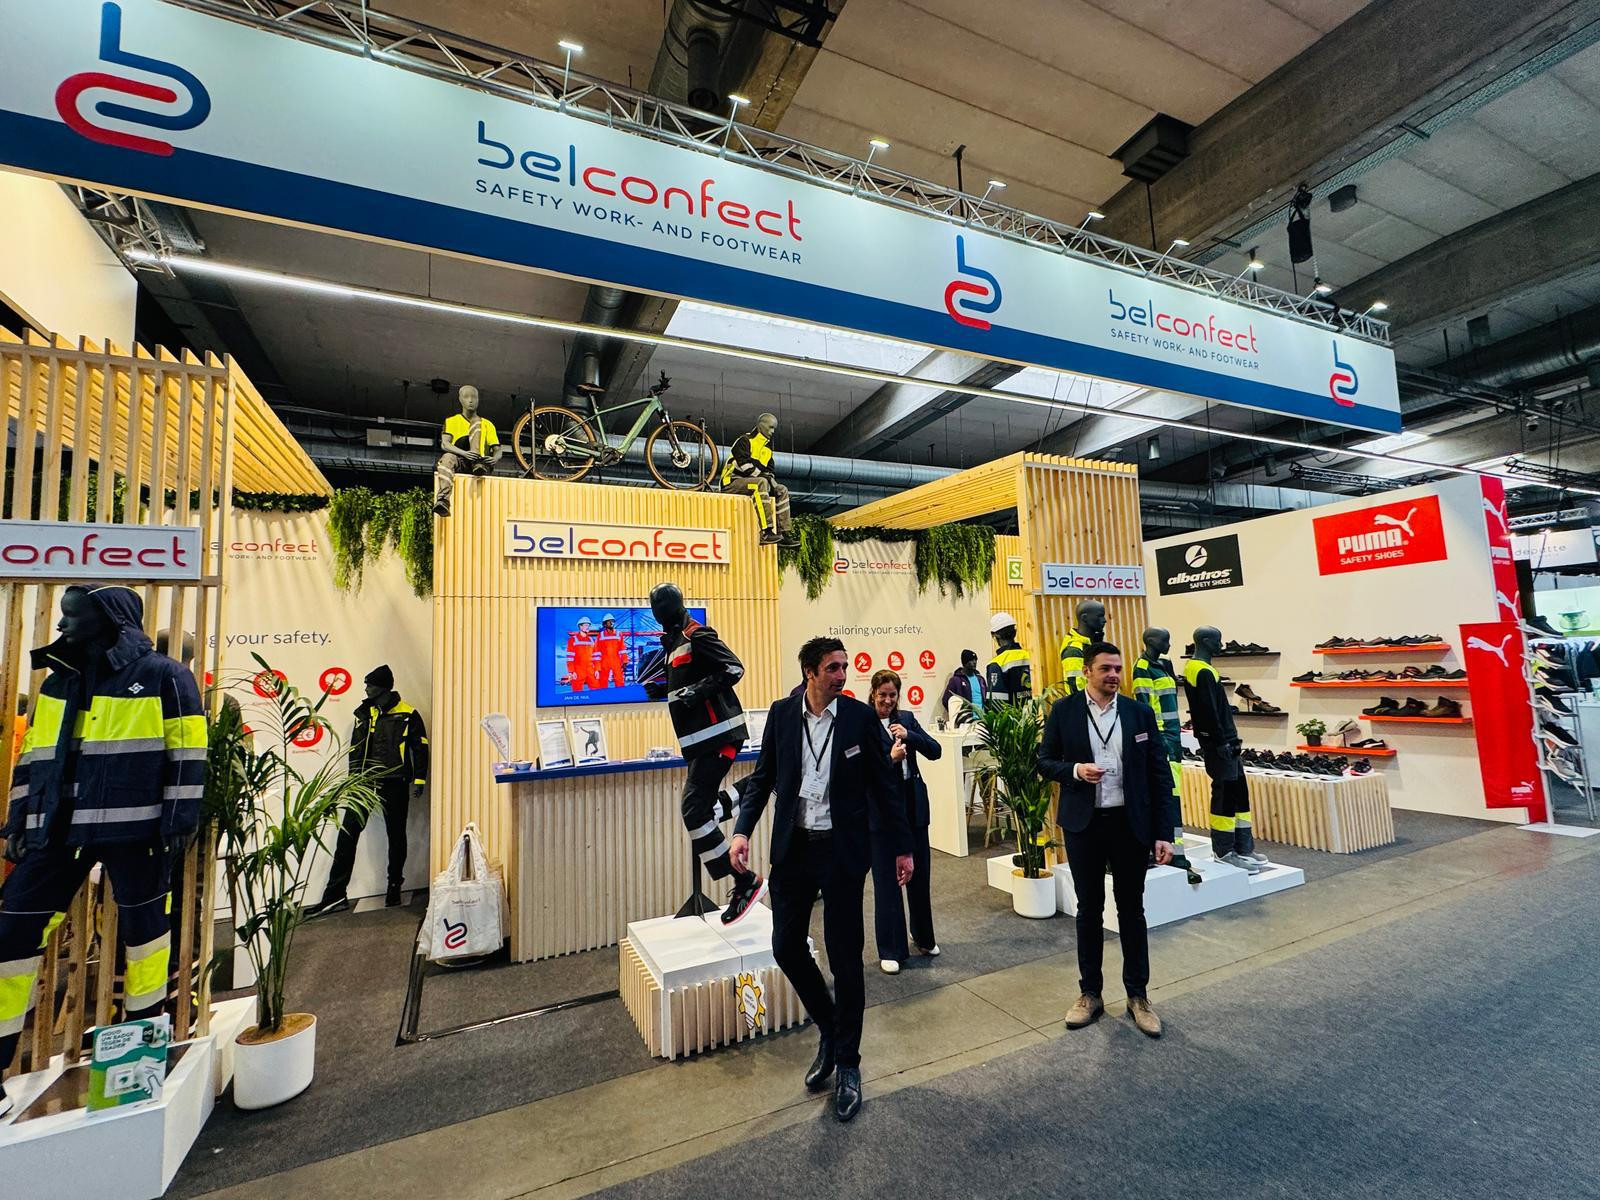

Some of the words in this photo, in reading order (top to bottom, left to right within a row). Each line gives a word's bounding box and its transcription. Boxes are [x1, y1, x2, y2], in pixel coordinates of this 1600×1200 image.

[477, 120, 803, 242] belconfect
[476, 179, 563, 210] SAFETY
[573, 200, 644, 227] WORK-
[652, 220, 693, 240] AND
[701, 231, 802, 265] FOOTWEAR
[1109, 288, 1259, 354] belconfect
[1111, 328, 1150, 345] SAFETY
[1153, 338, 1185, 353] WORK-
[1188, 346, 1208, 359] AND
[1211, 351, 1260, 370] FOOTWEAR
[2, 534, 187, 567] onfect
[513, 524, 722, 560] belconfect
[1337, 528, 1403, 555] PUMA
[852, 559, 912, 570] belconfect
[1341, 554, 1373, 565] SAFETY
[1375, 550, 1404, 561] SHOES
[1047, 570, 1141, 589] belconfect
[1167, 569, 1231, 585] albatros
[1190, 580, 1211, 589] SAFETY
[1212, 578, 1231, 586] SHOES
[226, 633, 269, 647] your
[273, 630, 331, 646] safety.
[829, 625, 869, 637] tailoring
[871, 627, 892, 635] your
[894, 624, 923, 635] safety.
